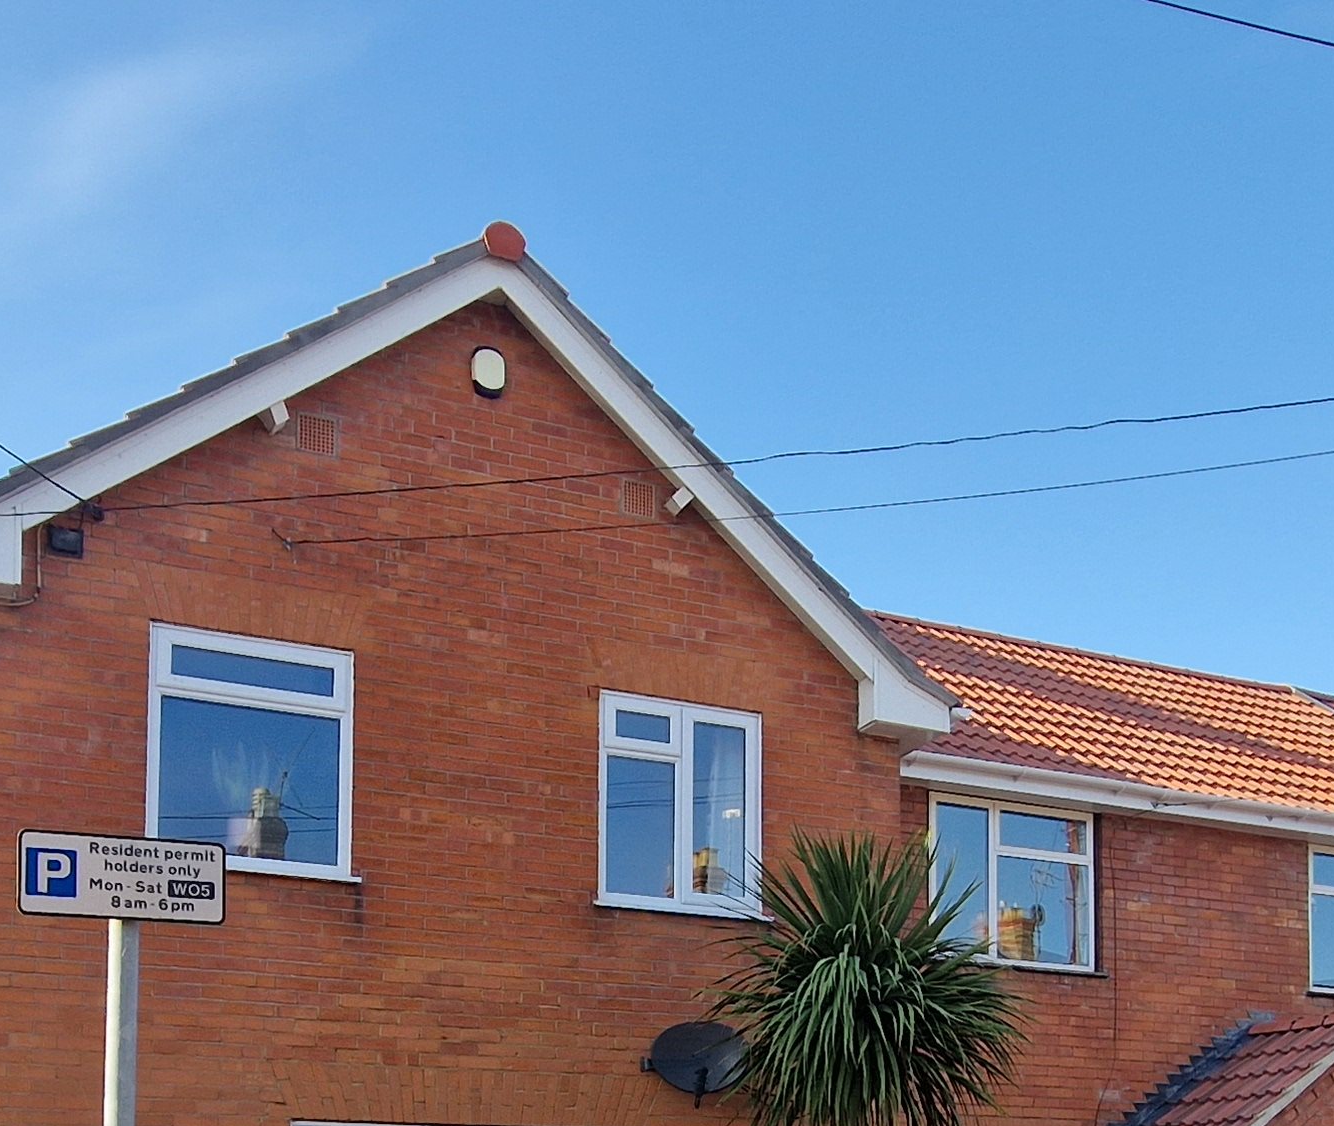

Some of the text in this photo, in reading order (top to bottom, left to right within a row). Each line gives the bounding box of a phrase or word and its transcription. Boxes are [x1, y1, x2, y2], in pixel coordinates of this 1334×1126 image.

[89, 842, 216, 863] Resident permit
[37, 852, 71, 894] P
[104, 859, 201, 879] holders only
[89, 878, 123, 892] Mon
[135, 881, 163, 894] Sat
